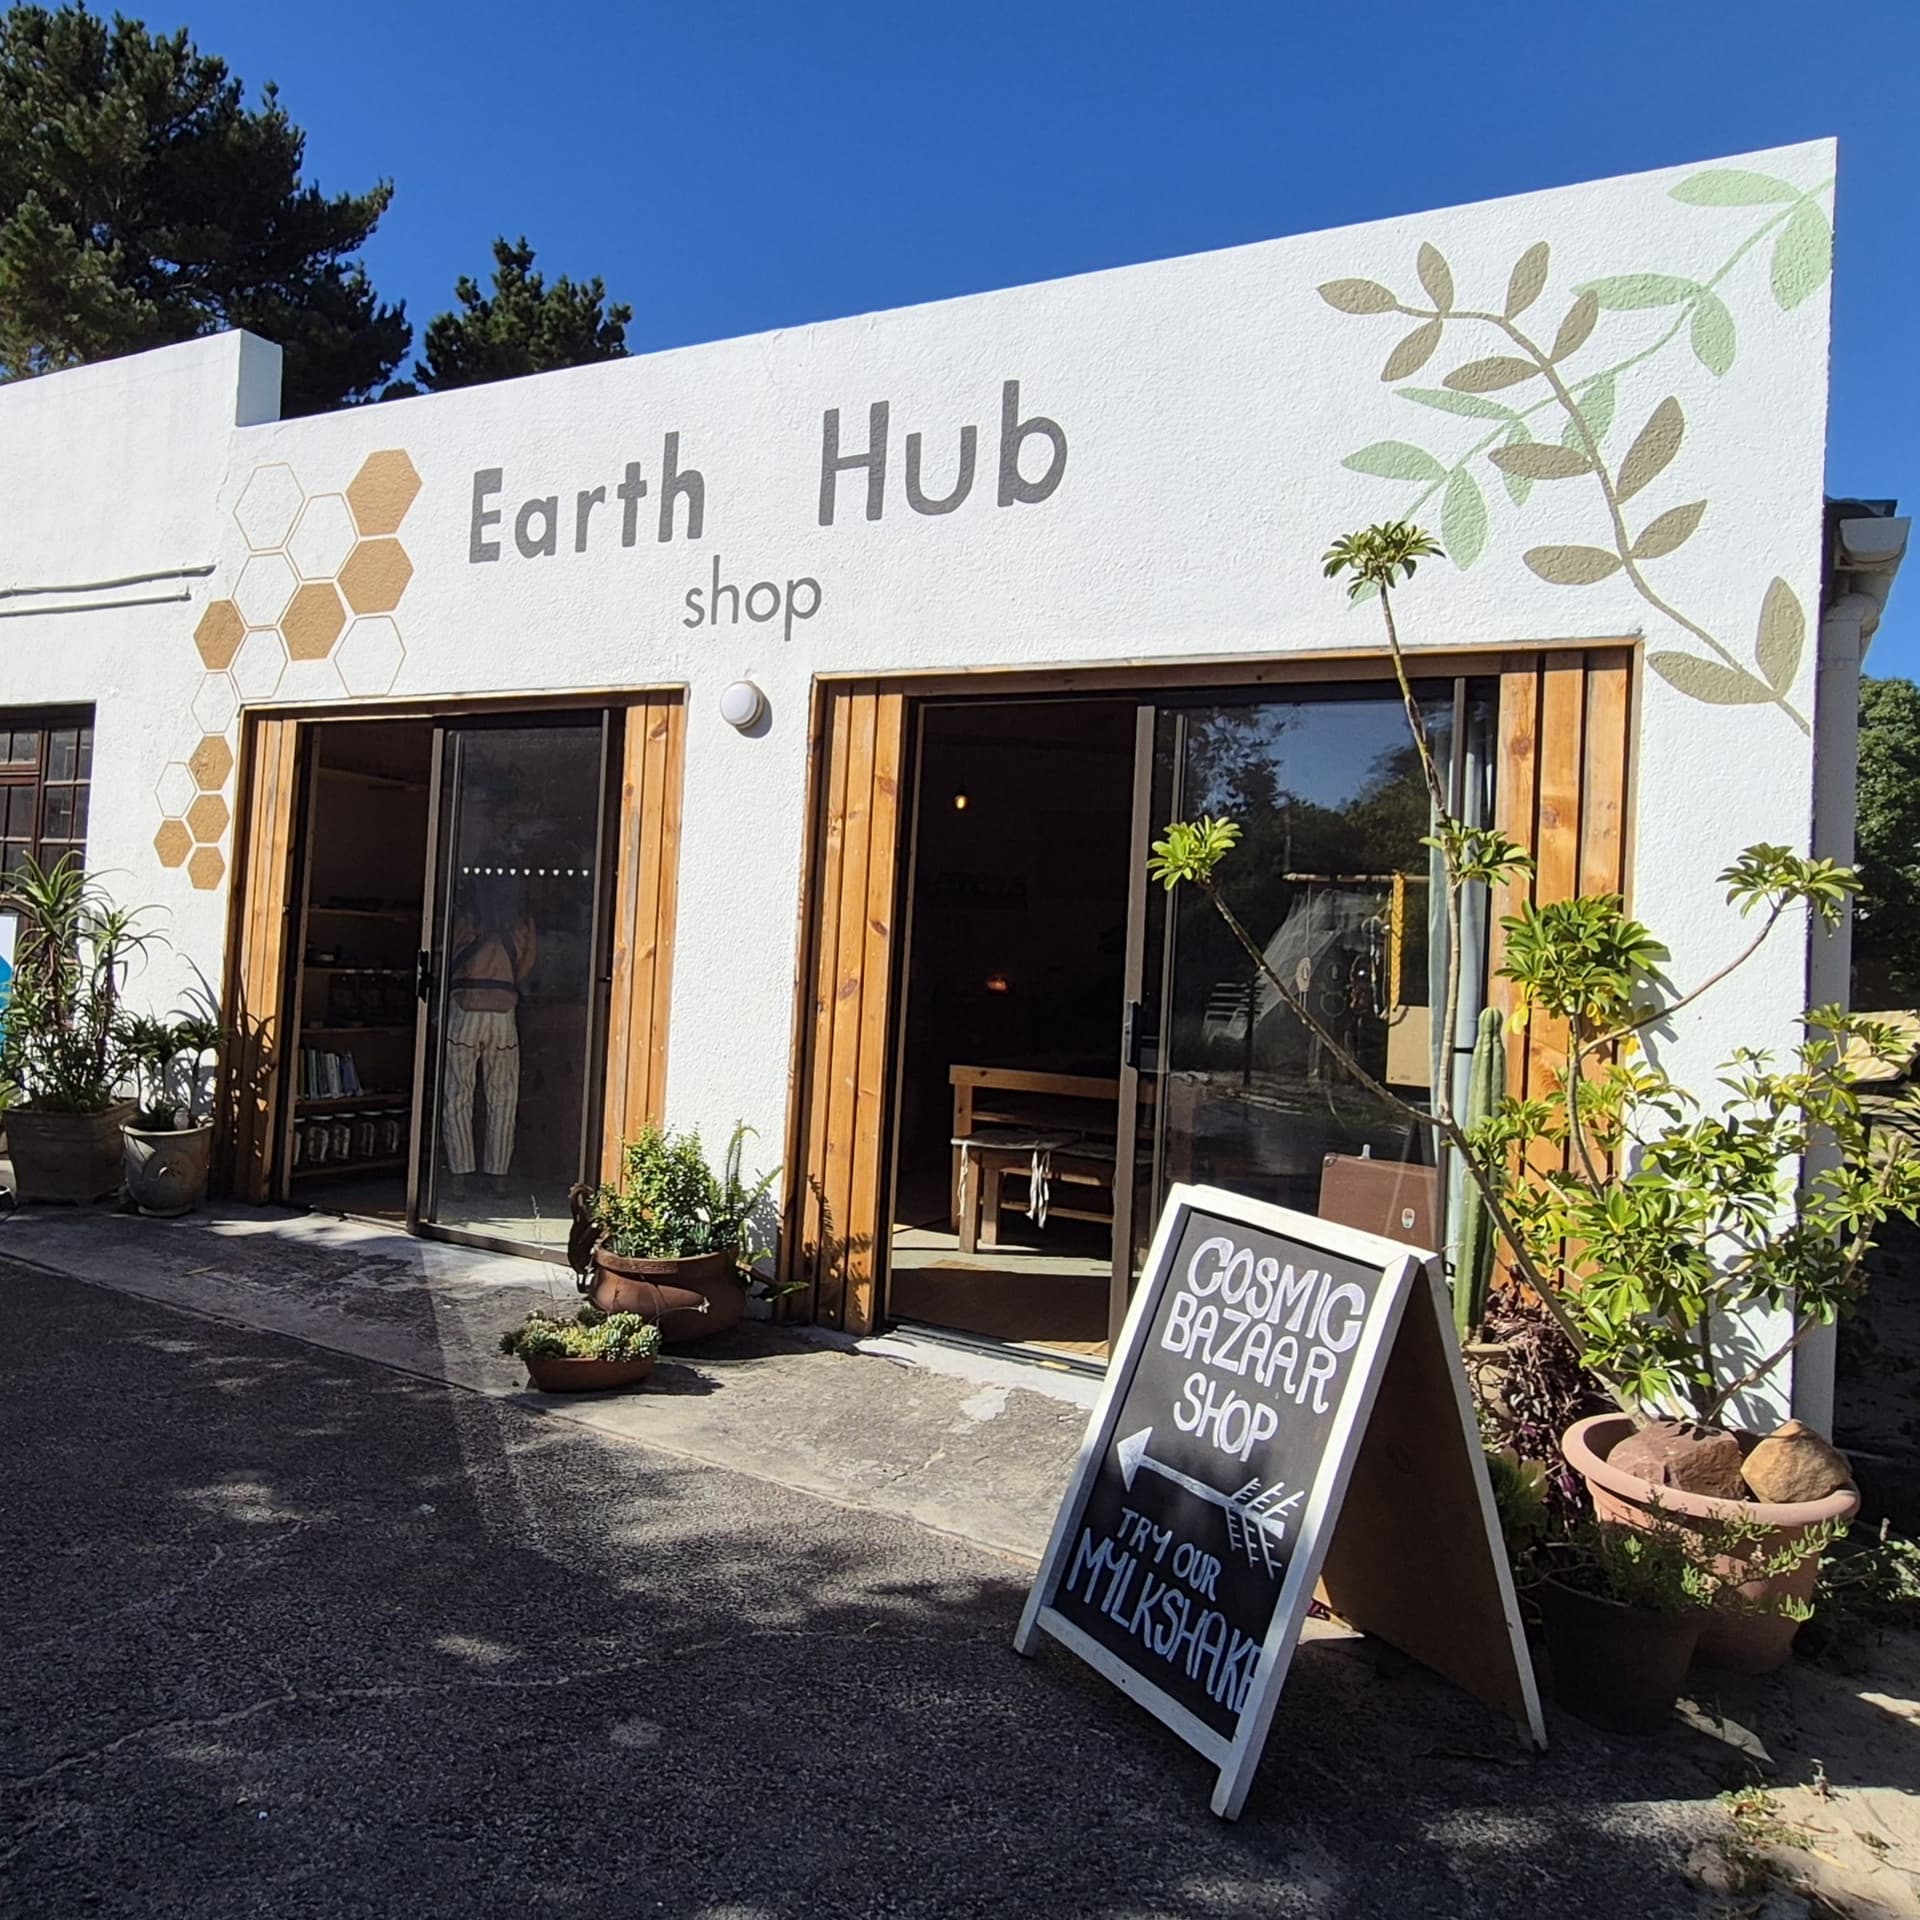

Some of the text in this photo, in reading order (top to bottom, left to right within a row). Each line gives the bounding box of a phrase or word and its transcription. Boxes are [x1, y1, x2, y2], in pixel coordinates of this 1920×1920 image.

[469, 380, 1068, 563] Earth Hub
[683, 554, 822, 642] shop
[1187, 1236, 1365, 1353] COSMIC
[1161, 1291, 1337, 1414] BAZAAR
[1173, 1371, 1278, 1462] SHOP
[1120, 1506, 1223, 1603] TRY OUR
